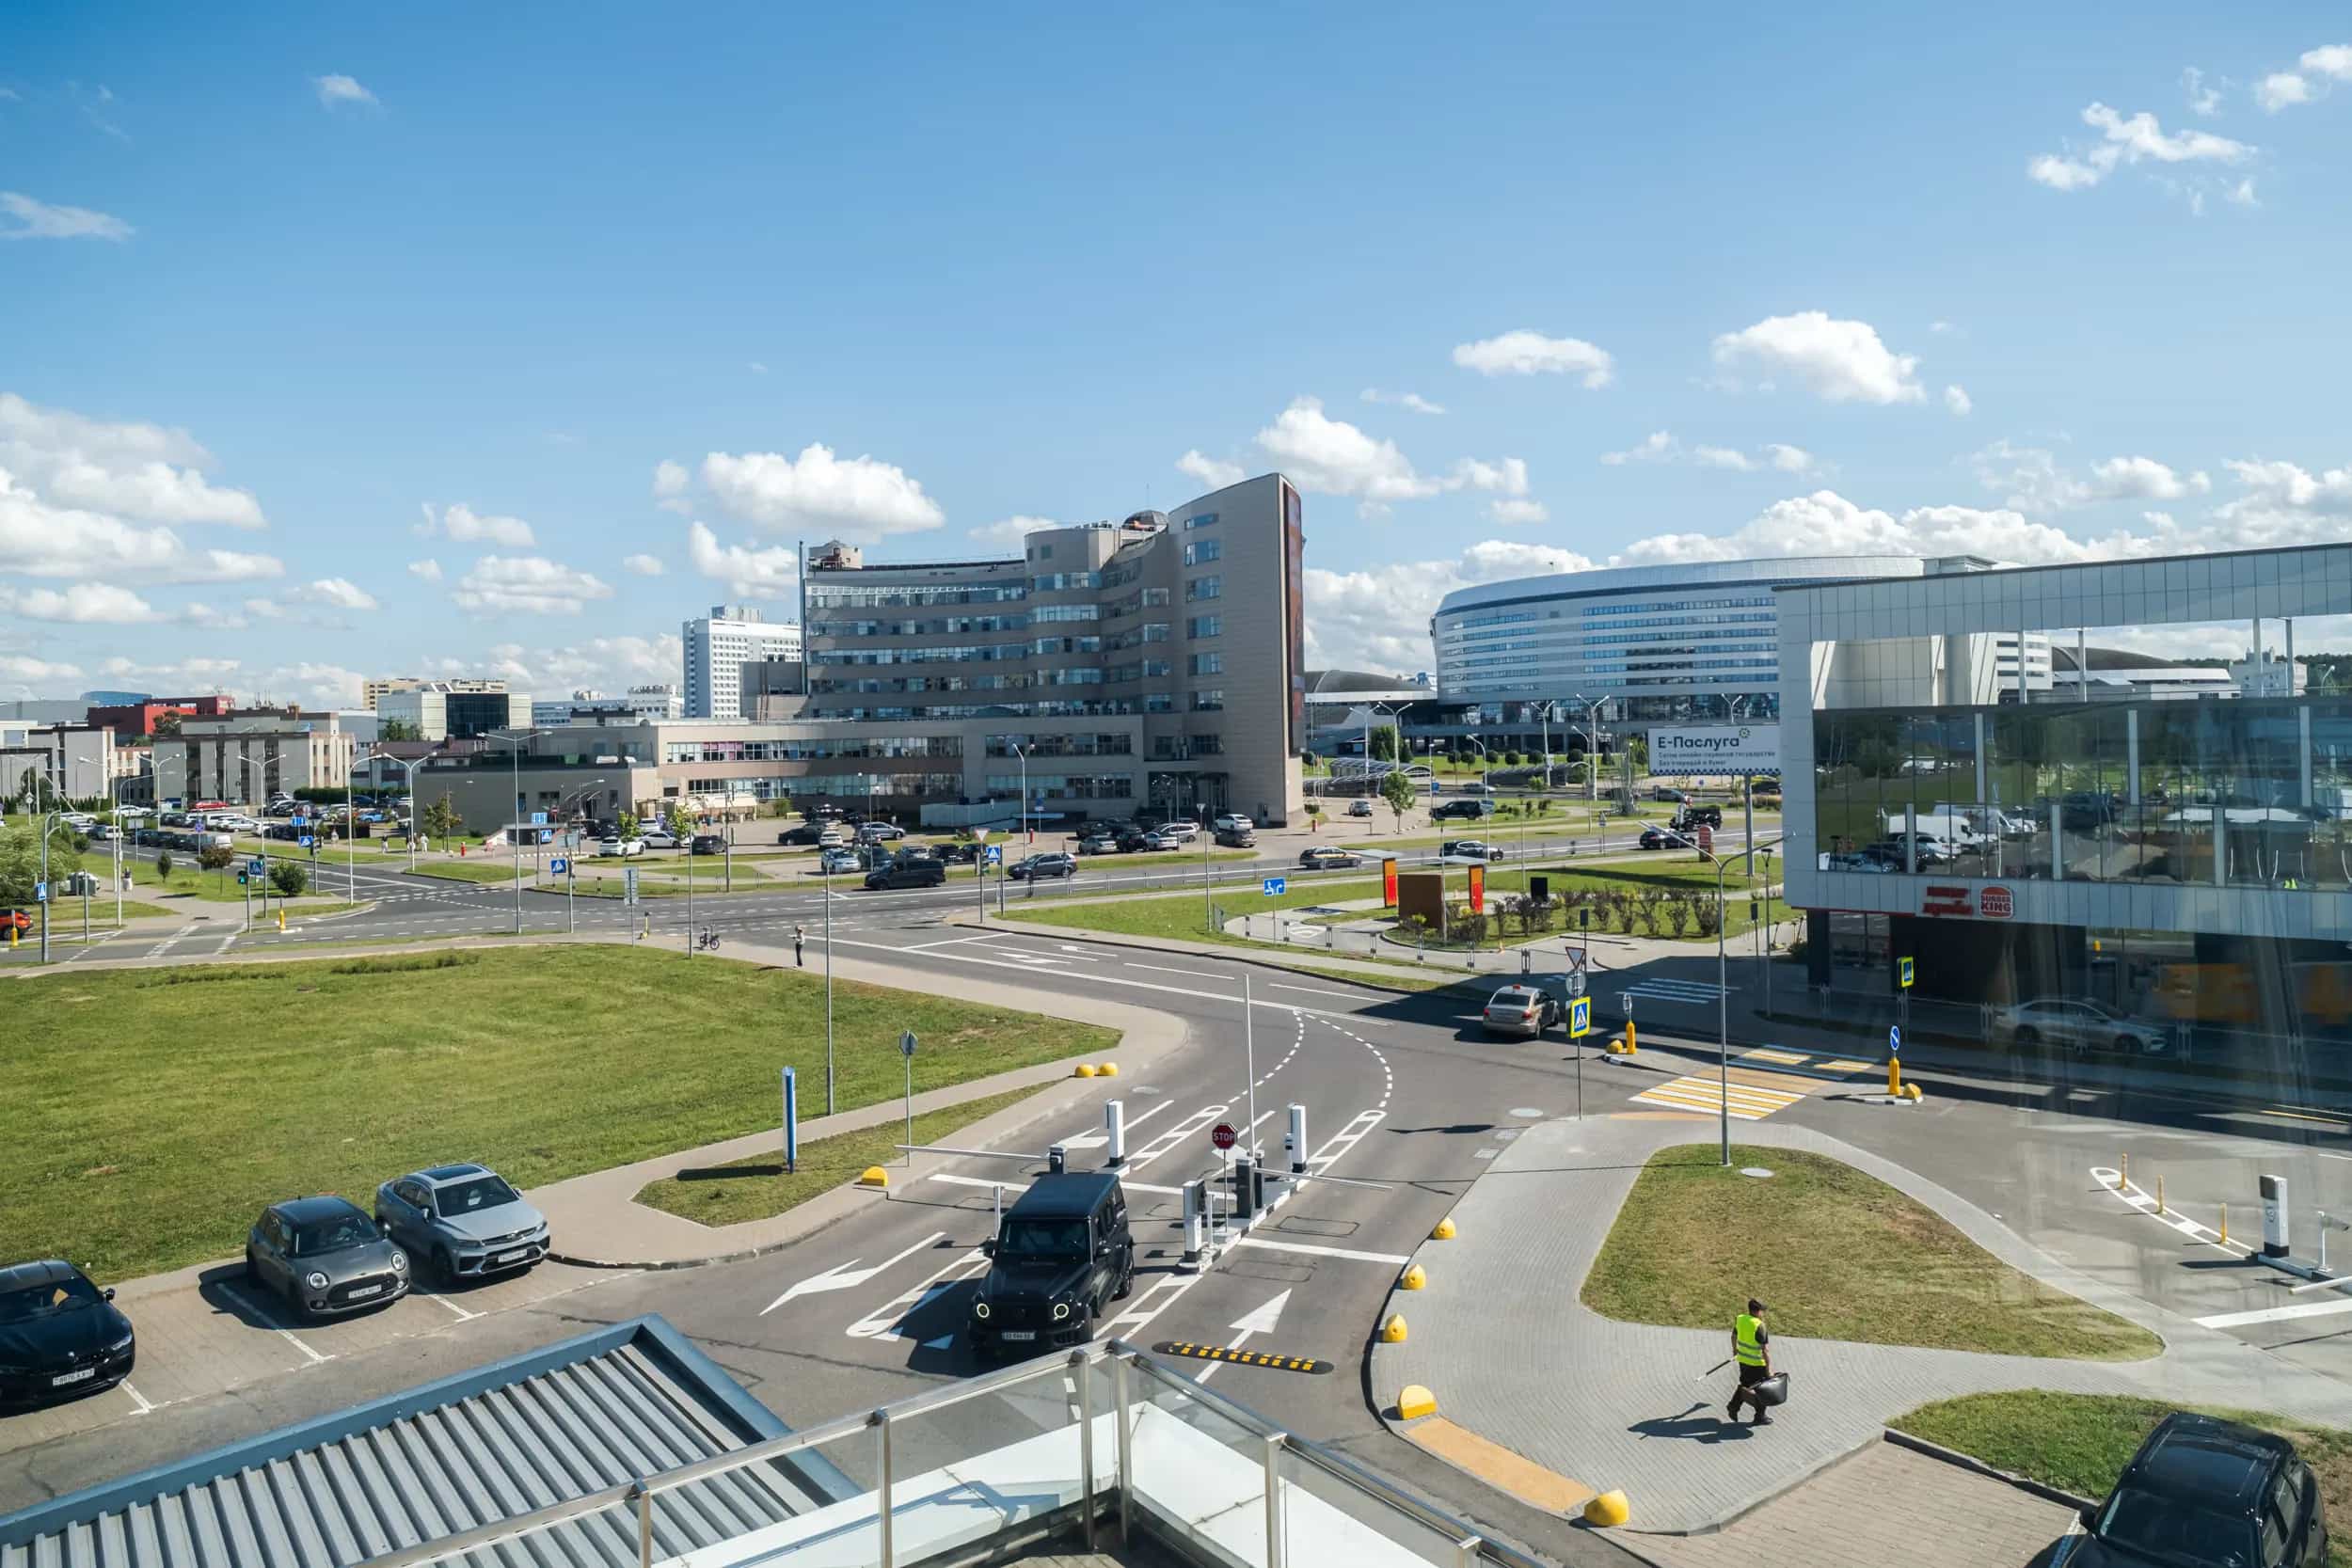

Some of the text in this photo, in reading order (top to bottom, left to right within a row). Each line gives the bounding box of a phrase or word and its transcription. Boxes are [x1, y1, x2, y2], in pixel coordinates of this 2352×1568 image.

[1658, 736, 1740, 752] Е-Паслуга
[1980, 902, 2011, 912] KING
[1214, 1132, 1234, 1142] STOP
